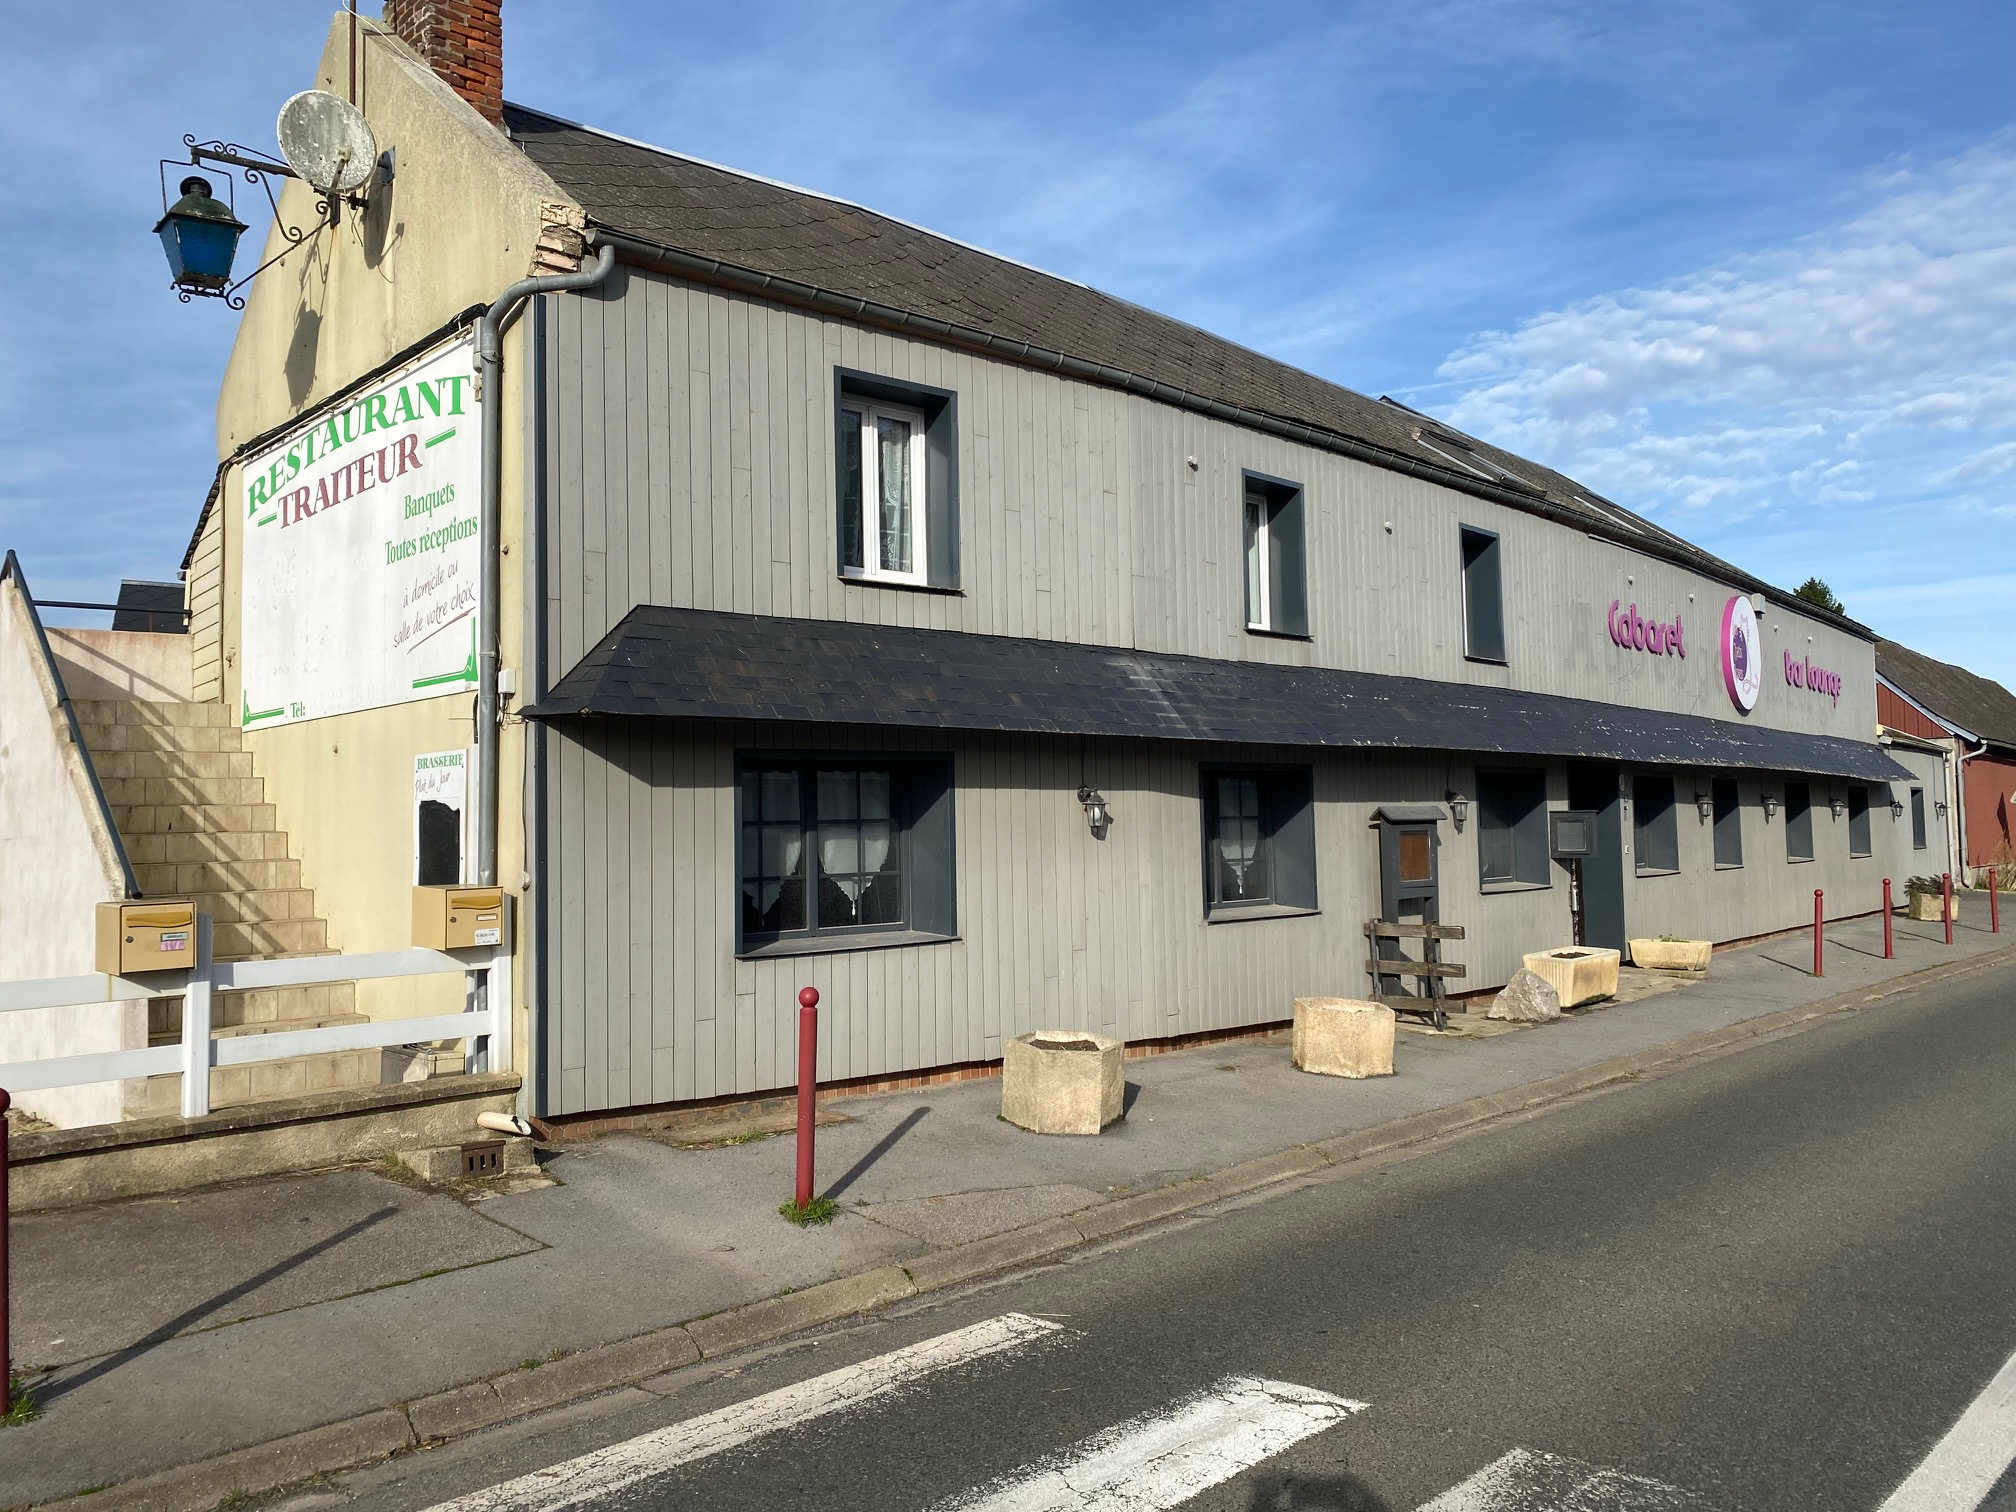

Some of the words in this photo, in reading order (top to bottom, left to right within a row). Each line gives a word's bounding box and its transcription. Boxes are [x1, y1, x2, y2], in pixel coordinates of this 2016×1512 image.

[247, 375, 470, 519] RESTAURANT
[277, 433, 423, 529] TRAITEUR
[404, 482, 455, 520] Banquets
[384, 537, 417, 566] Toutes
[419, 515, 478, 554] réceptions
[402, 587, 409, 608] à
[411, 564, 444, 603] domicile
[447, 560, 459, 579] ou
[393, 623, 411, 648] salle
[412, 611, 423, 633] de
[426, 601, 448, 625] votre
[450, 580, 476, 610] choix
[1608, 599, 1686, 660] Cabaret
[1804, 655, 1842, 710] lounge
[417, 753, 464, 770] BRASSERIE
